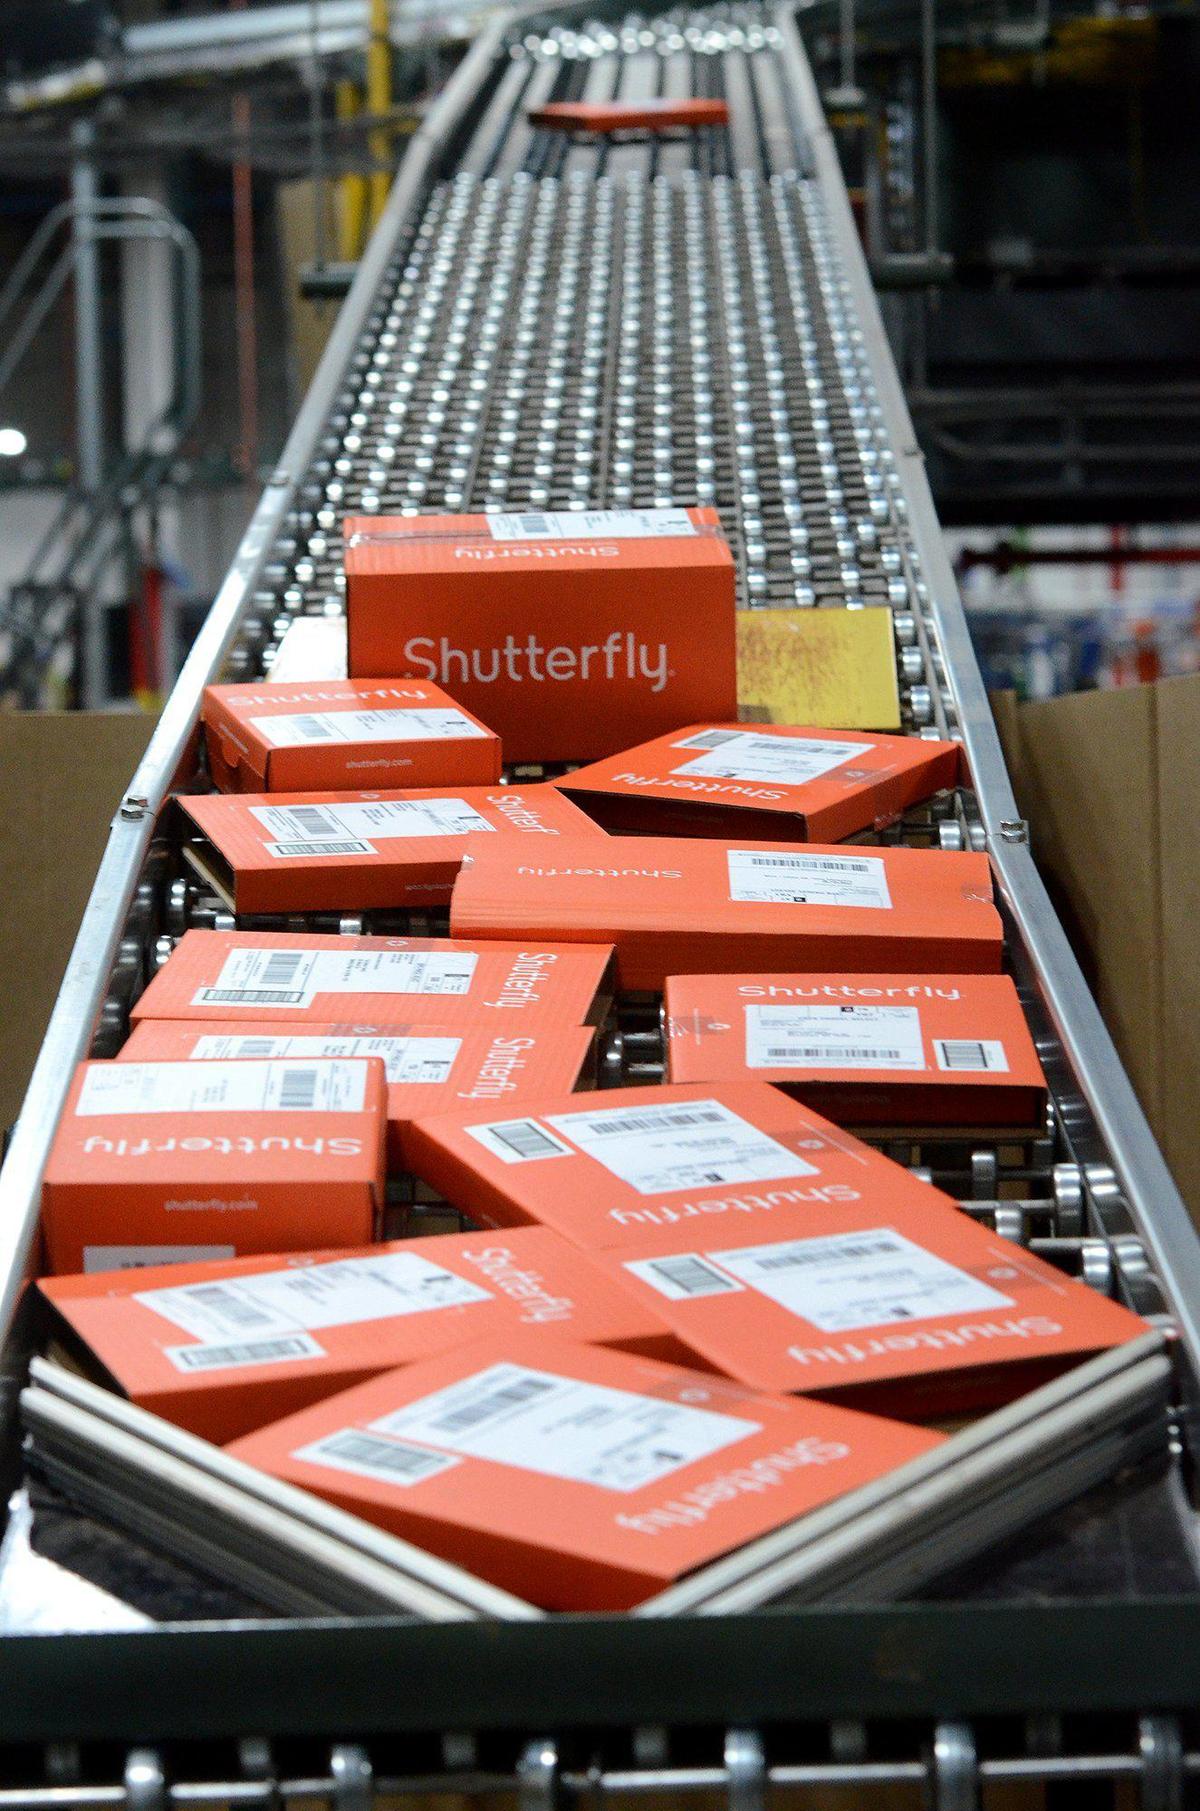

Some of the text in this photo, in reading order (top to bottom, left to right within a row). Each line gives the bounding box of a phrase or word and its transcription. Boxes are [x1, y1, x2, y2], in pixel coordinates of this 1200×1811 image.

[404, 632, 672, 692] Shutterfly
[226, 687, 430, 706] Shutterfly
[611, 773, 791, 801] Shutterfly
[517, 866, 683, 878] Shutterfly
[483, 952, 559, 1009] Shutterfly
[737, 985, 963, 1001] Shutterfly
[456, 1036, 557, 1099] Shutterfly
[82, 1136, 364, 1157] Shutterfly
[606, 1184, 863, 1227] Shutterfly
[461, 1247, 576, 1324] Shutterfly
[786, 1316, 1063, 1365] Shutterfly
[615, 1437, 851, 1536] Shutterfly
